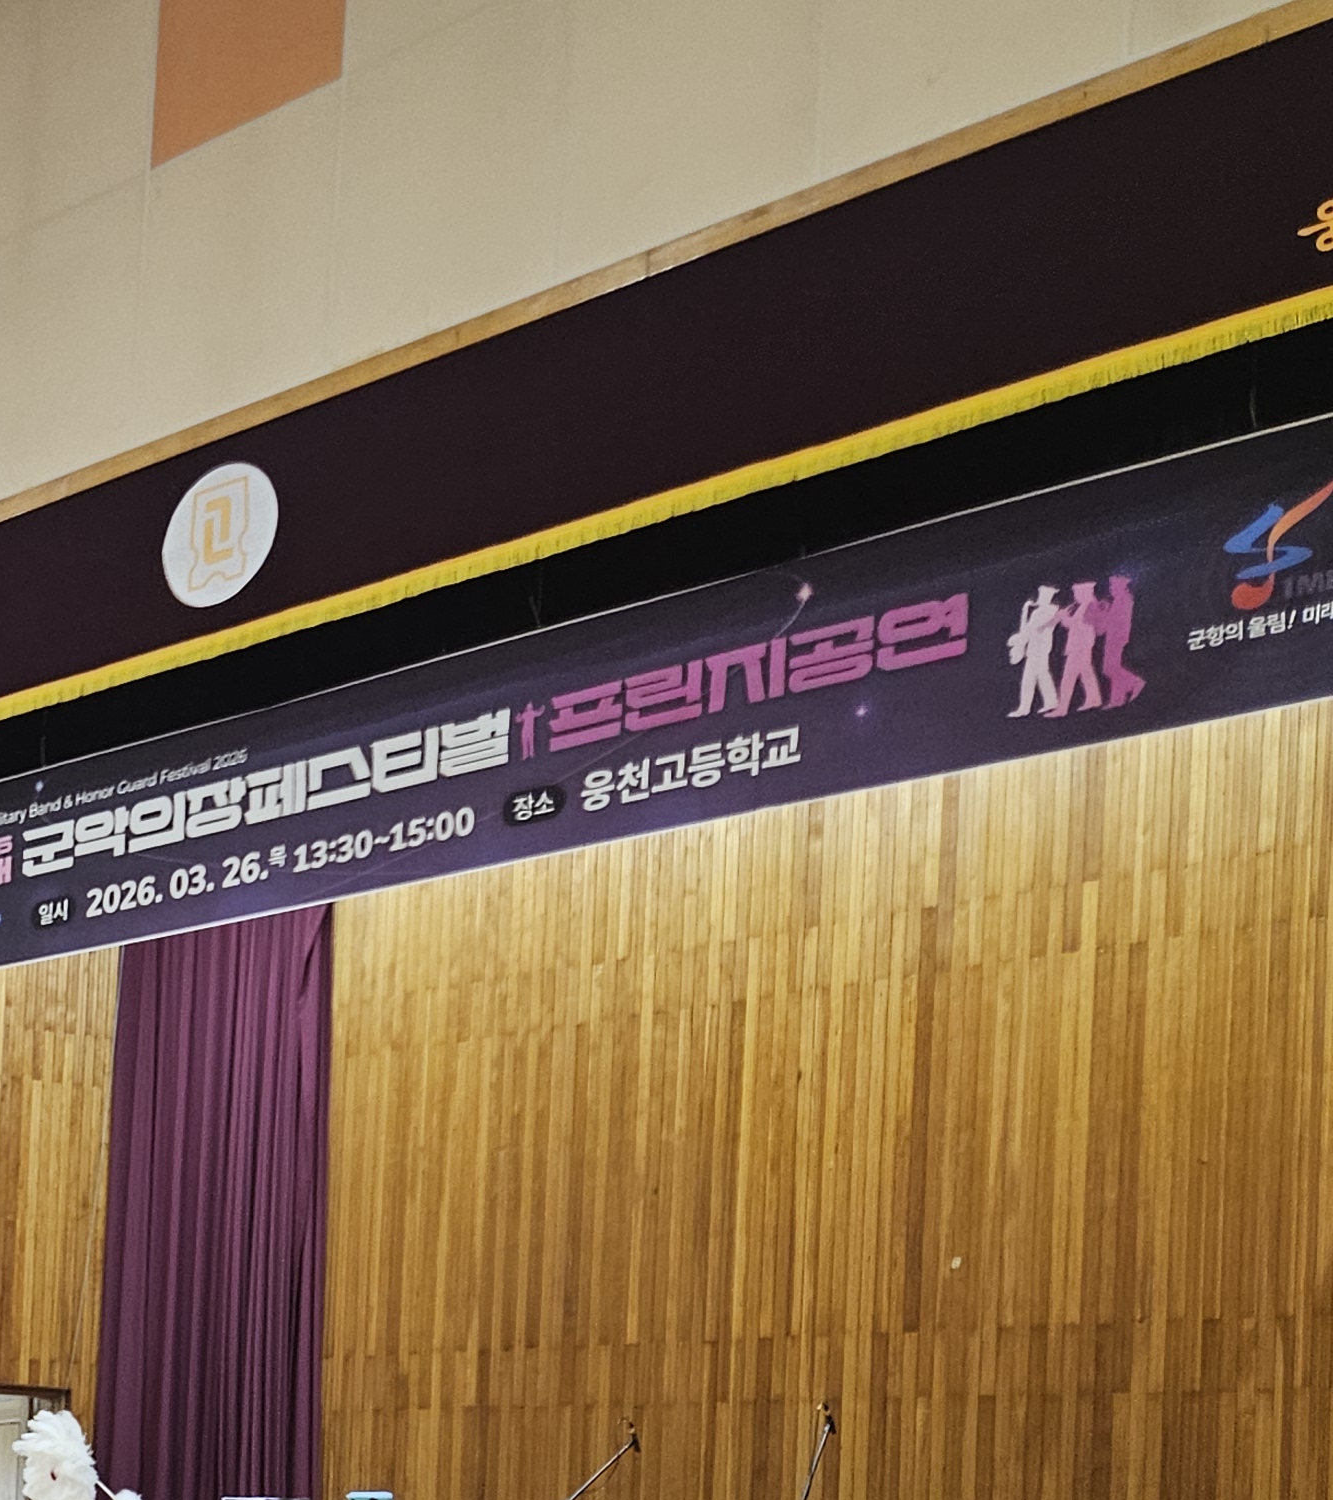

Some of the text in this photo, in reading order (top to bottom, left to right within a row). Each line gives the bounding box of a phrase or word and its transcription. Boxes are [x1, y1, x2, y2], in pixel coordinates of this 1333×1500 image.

[1187, 619, 1244, 651] 군항의
[1247, 609, 1297, 639] 울림!
[21, 592, 970, 877] 군악의장페스티벌 프린지공연
[511, 724, 802, 822] 장소 웅천고등학교
[29, 796, 62, 818] Band
[63, 795, 74, 809] &
[75, 785, 115, 805] Honor
[116, 774, 158, 795] Guard
[160, 759, 211, 785] Festival
[38, 899, 69, 926] 일시
[86, 875, 163, 918] 2026.
[169, 865, 215, 900] 03.
[292, 806, 476, 874] 13:30~15:00
